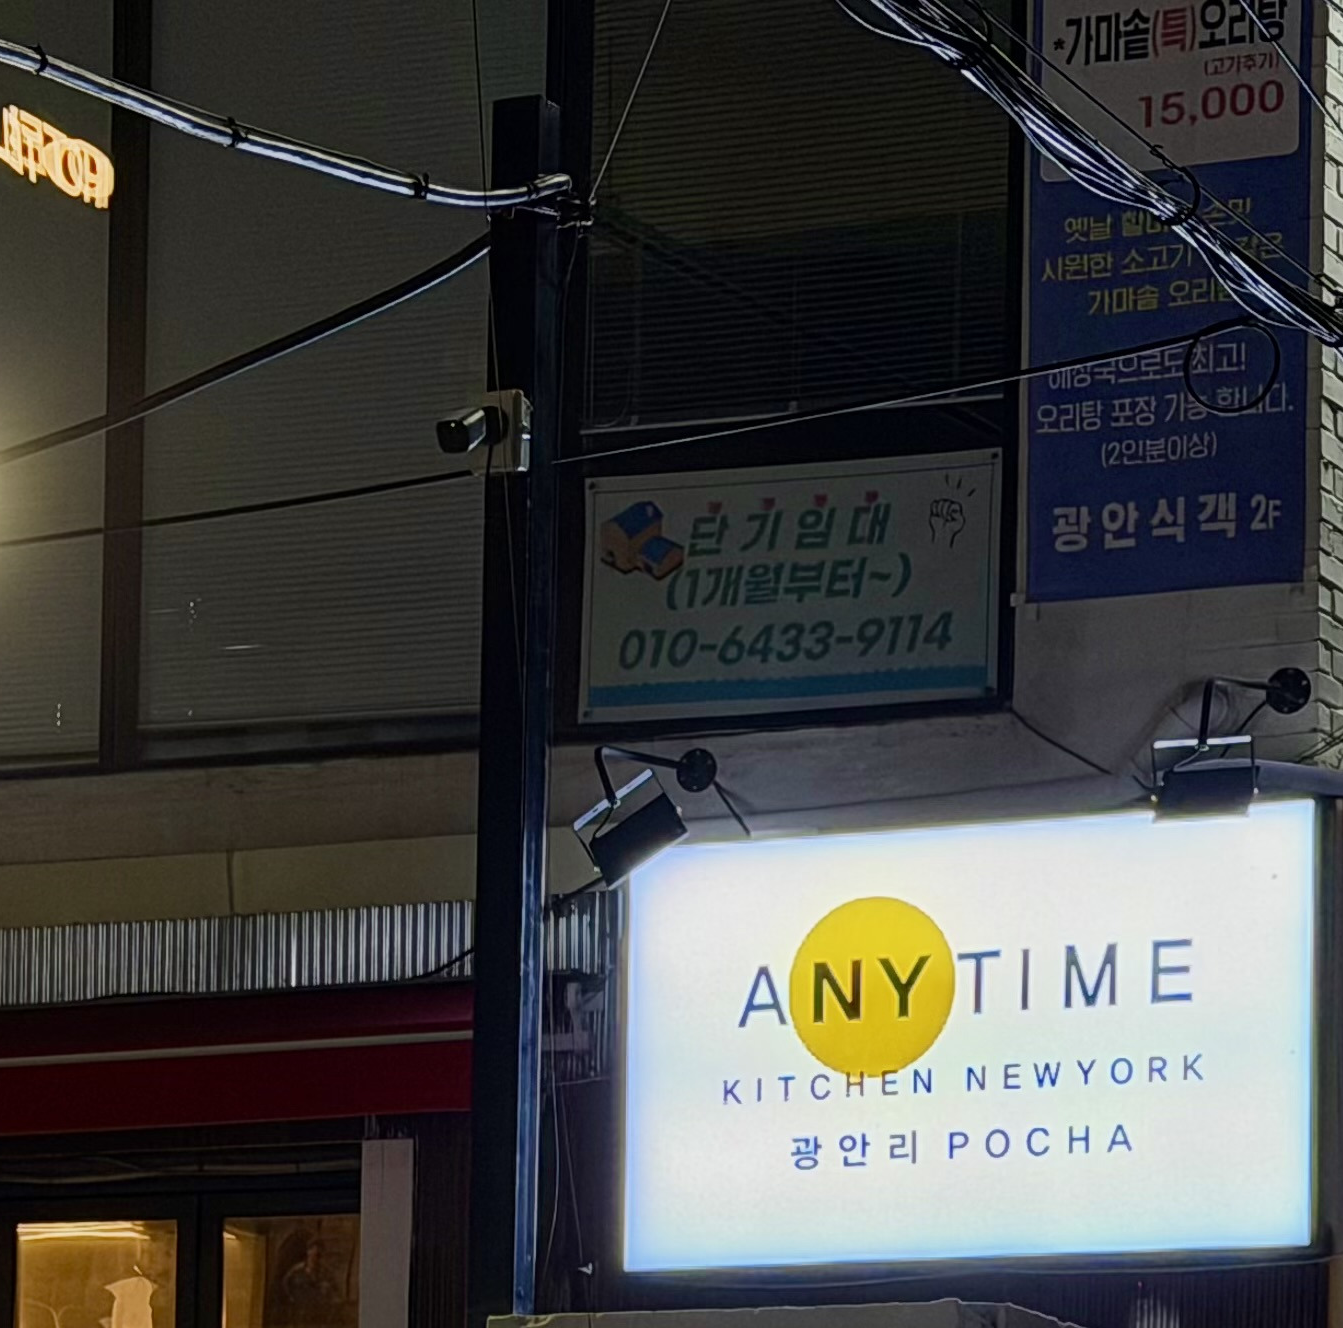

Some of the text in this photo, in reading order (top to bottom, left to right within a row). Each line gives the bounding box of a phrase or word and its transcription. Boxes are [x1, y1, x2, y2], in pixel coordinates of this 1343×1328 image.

[1138, 80, 1285, 128] 15,000
[1065, 214, 1112, 243] 옛날
[1042, 252, 1114, 281] 시원한
[1122, 243, 1193, 276] 소고기
[1192, 342, 1247, 373] 최고!
[1036, 401, 1103, 434] 오리탕
[1111, 396, 1156, 427] 포장
[1101, 432, 1217, 468] (2인분이상)
[687, 501, 892, 559] 단기임대
[1052, 493, 1282, 552] 광안식객 2F
[618, 611, 954, 670] 010-6433-9114
[738, 938, 1195, 1029] ANYTIME
[723, 1053, 1206, 1106] KITCHEN NEWYORK
[789, 1124, 1133, 1172] 광안리 POCHA
